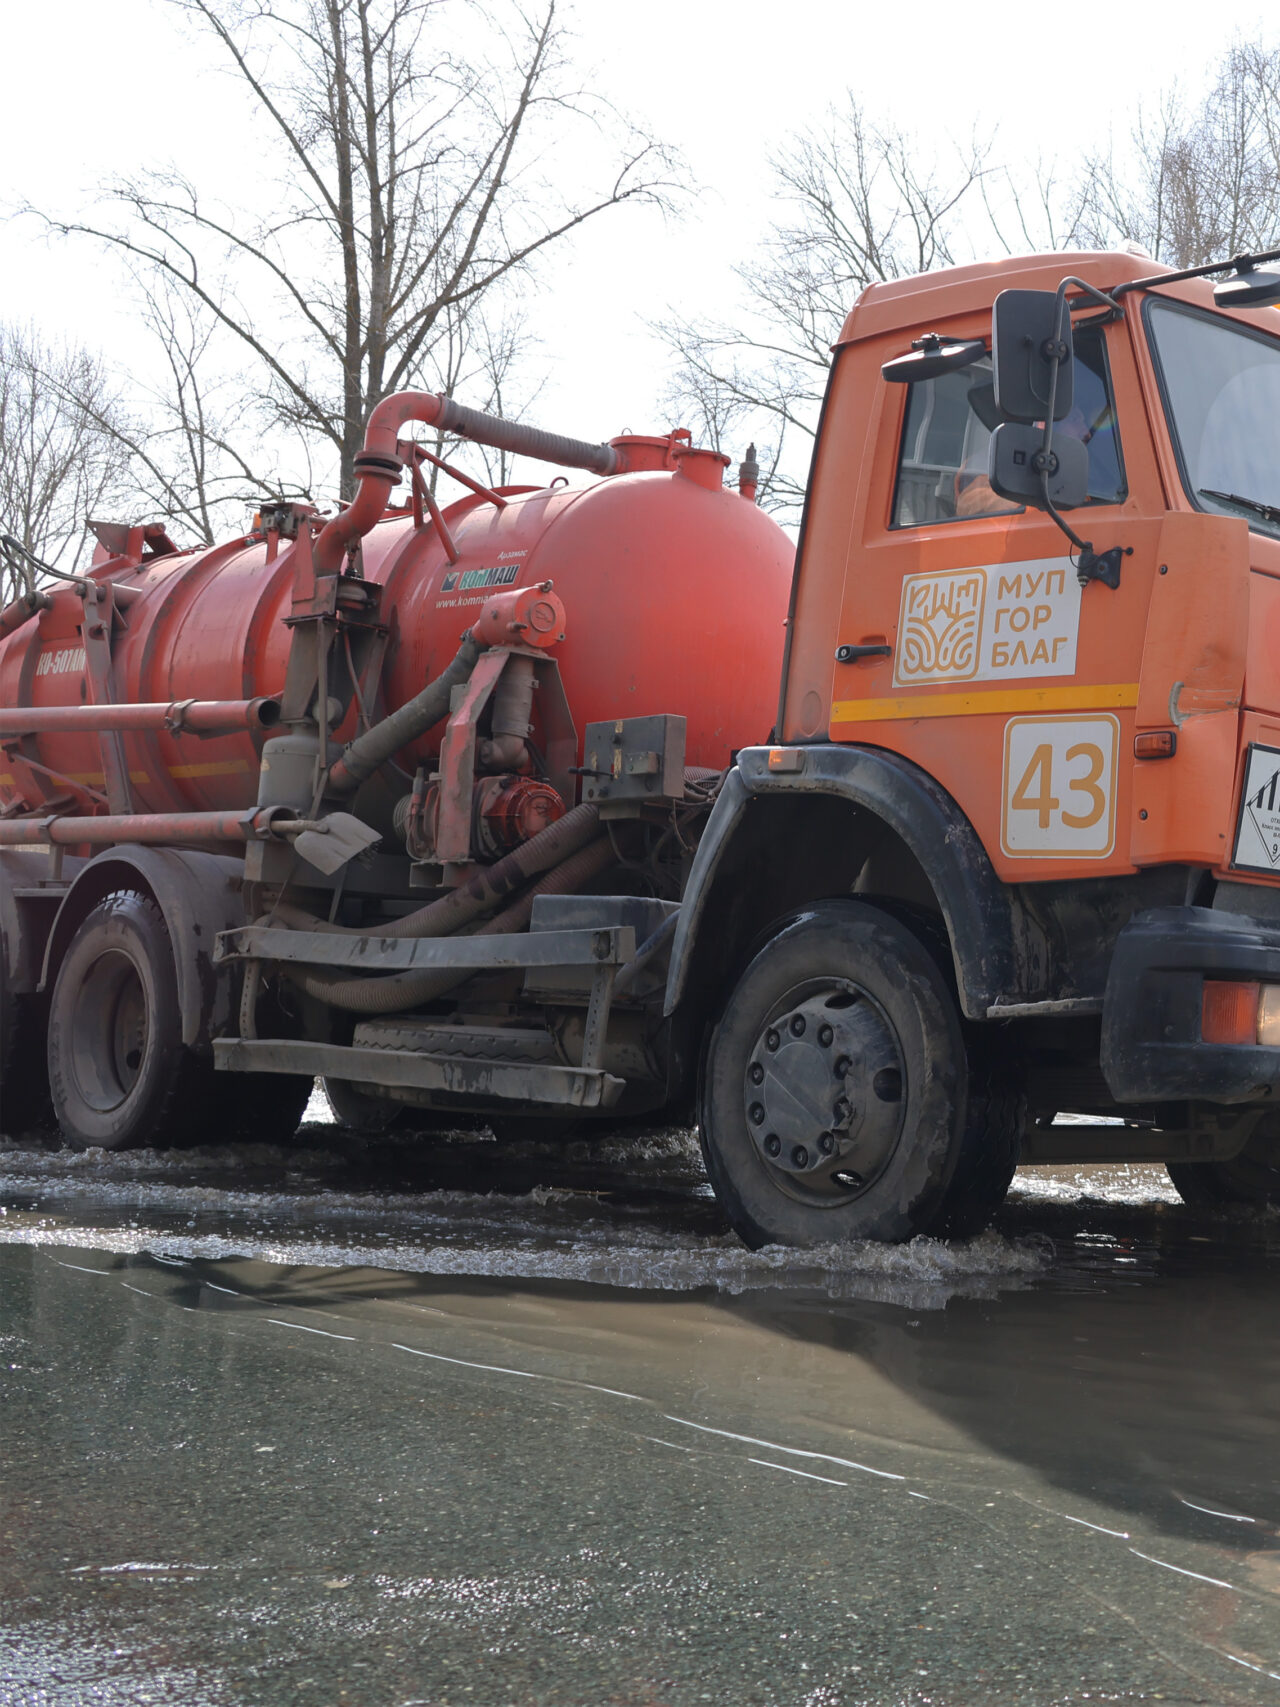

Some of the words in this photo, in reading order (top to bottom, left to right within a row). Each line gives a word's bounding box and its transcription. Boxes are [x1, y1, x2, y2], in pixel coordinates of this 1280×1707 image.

[459, 564, 520, 590] КОММАШ
[997, 569, 1066, 600] МУП
[436, 595, 490, 609] www.komma
[994, 605, 1052, 634] ГОР
[991, 637, 1068, 668] БЛАГ
[1012, 742, 1105, 829] 43
[1272, 843, 1278, 854] 9
